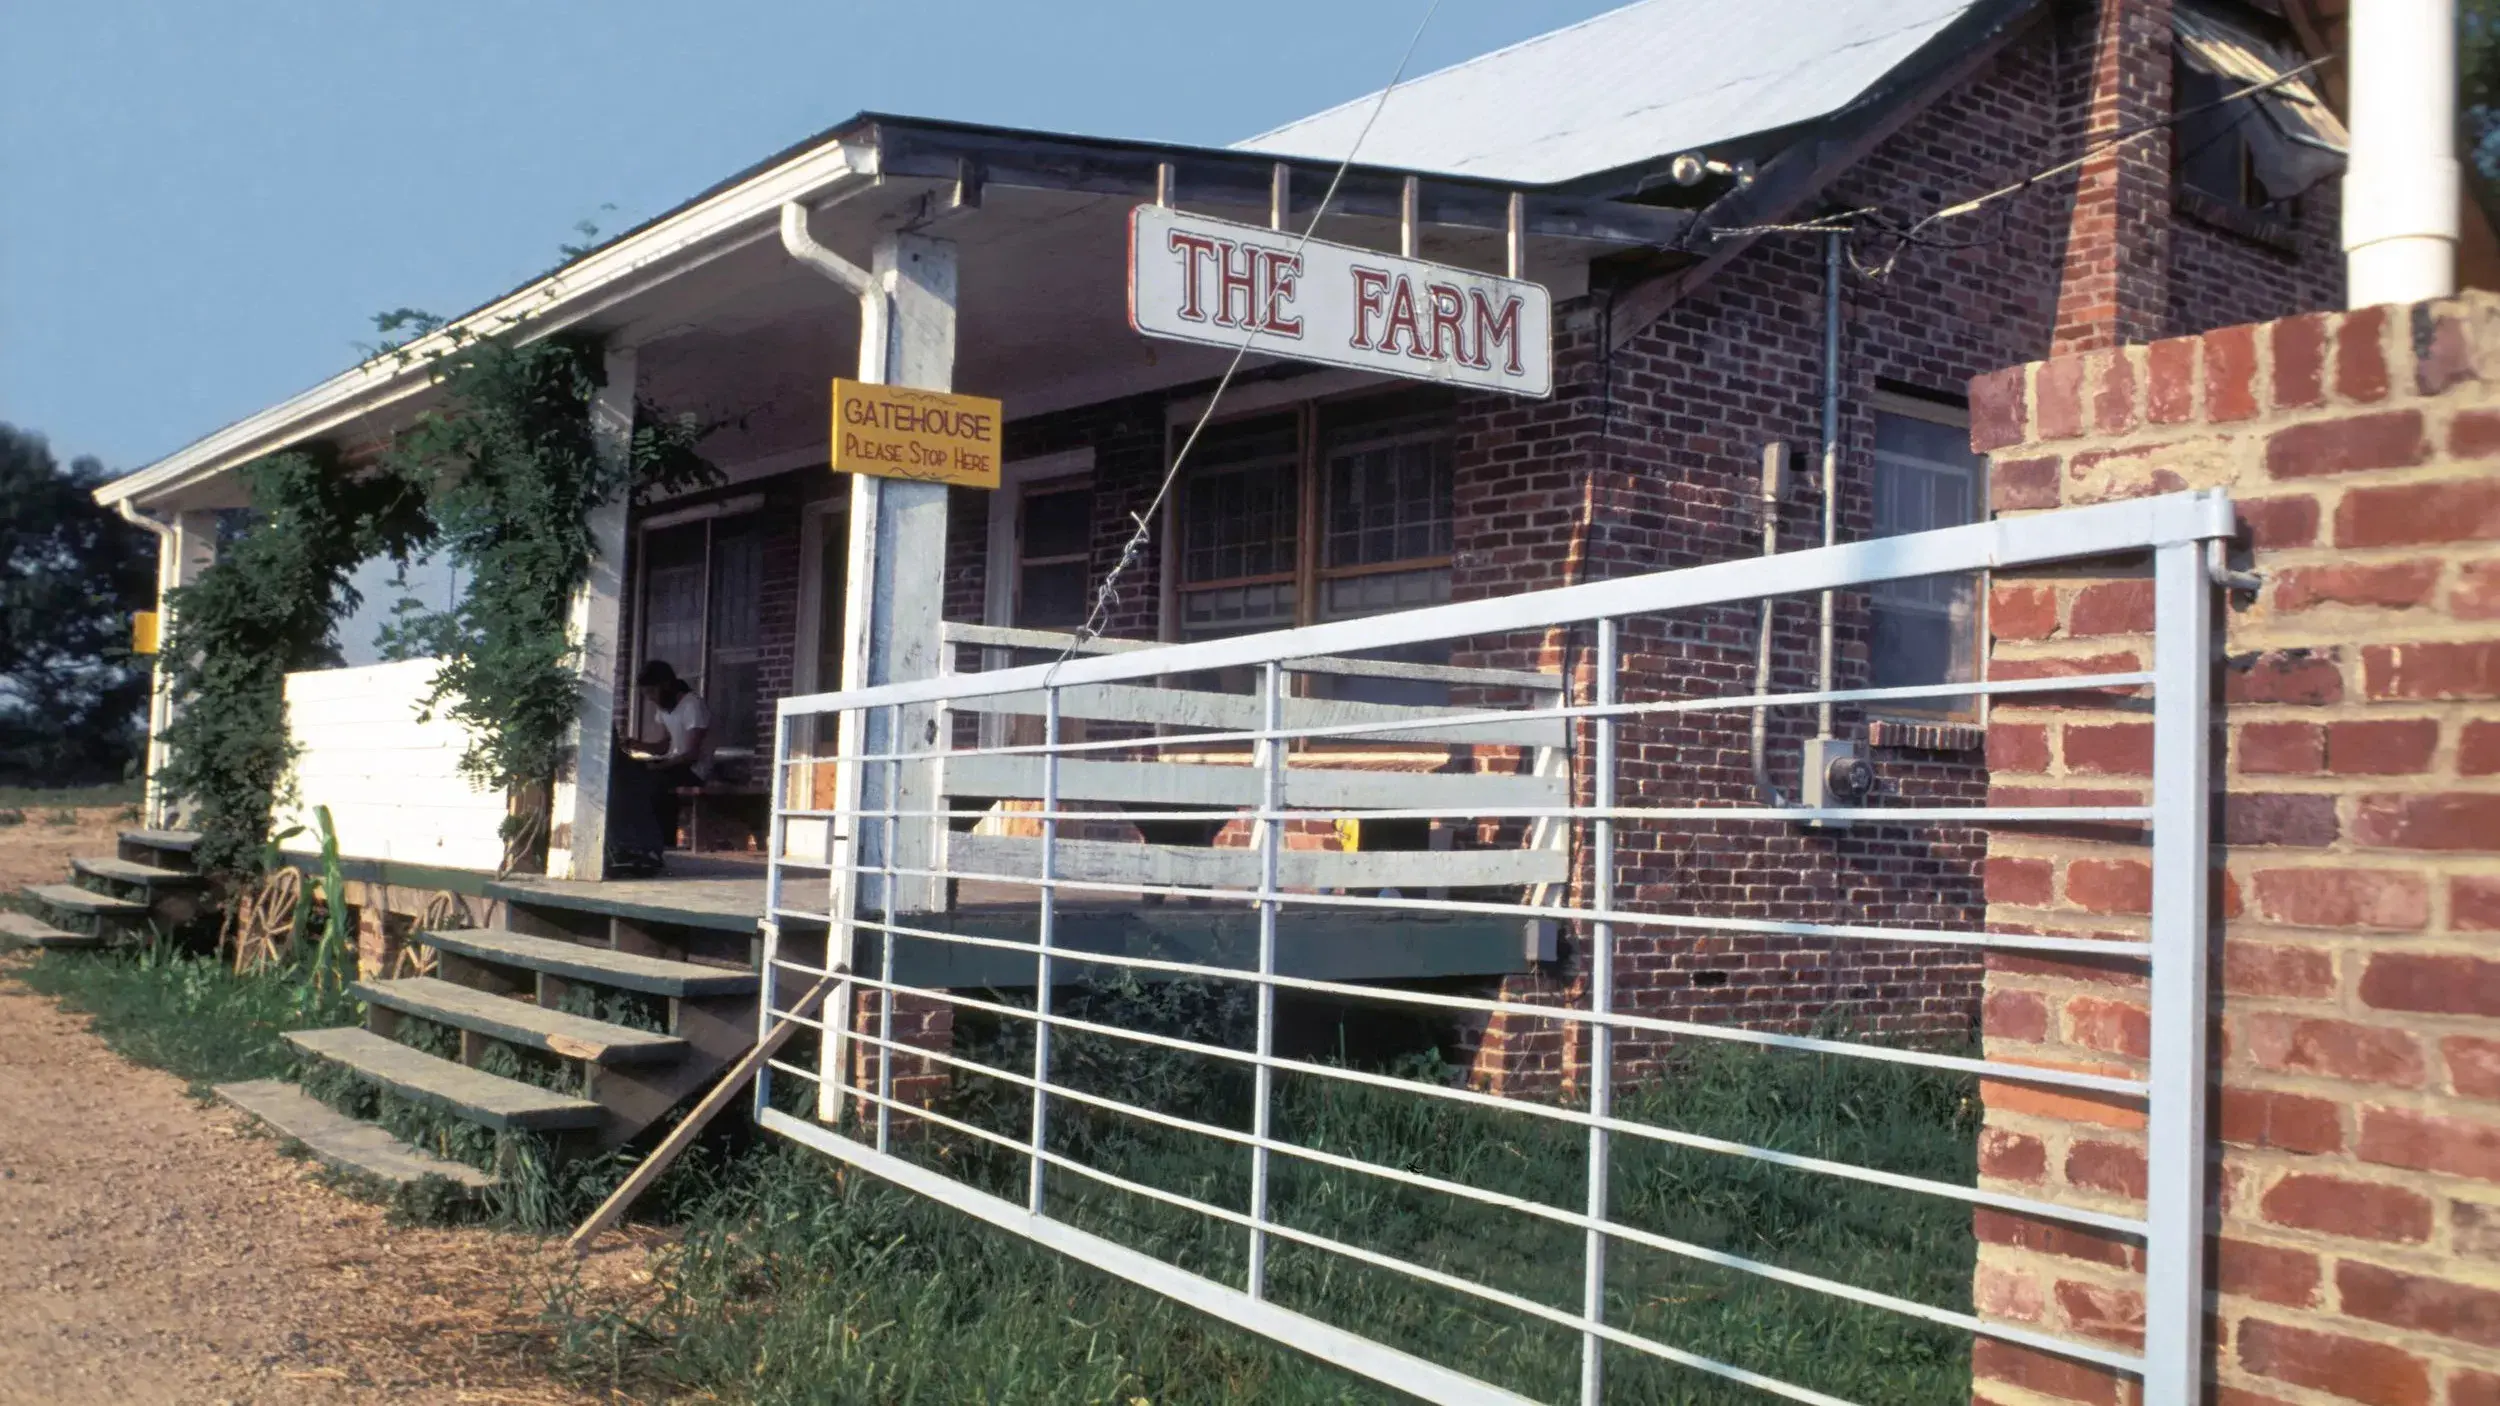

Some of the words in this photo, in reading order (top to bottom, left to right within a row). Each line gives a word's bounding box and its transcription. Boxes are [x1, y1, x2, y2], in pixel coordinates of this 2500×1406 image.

[1168, 227, 1304, 338] THE
[1350, 264, 1524, 376] FARM
[845, 398, 990, 441] GATEHOUSE
[845, 432, 902, 462] PLEASE
[910, 441, 947, 466] STOP
[954, 447, 989, 472] HERE
